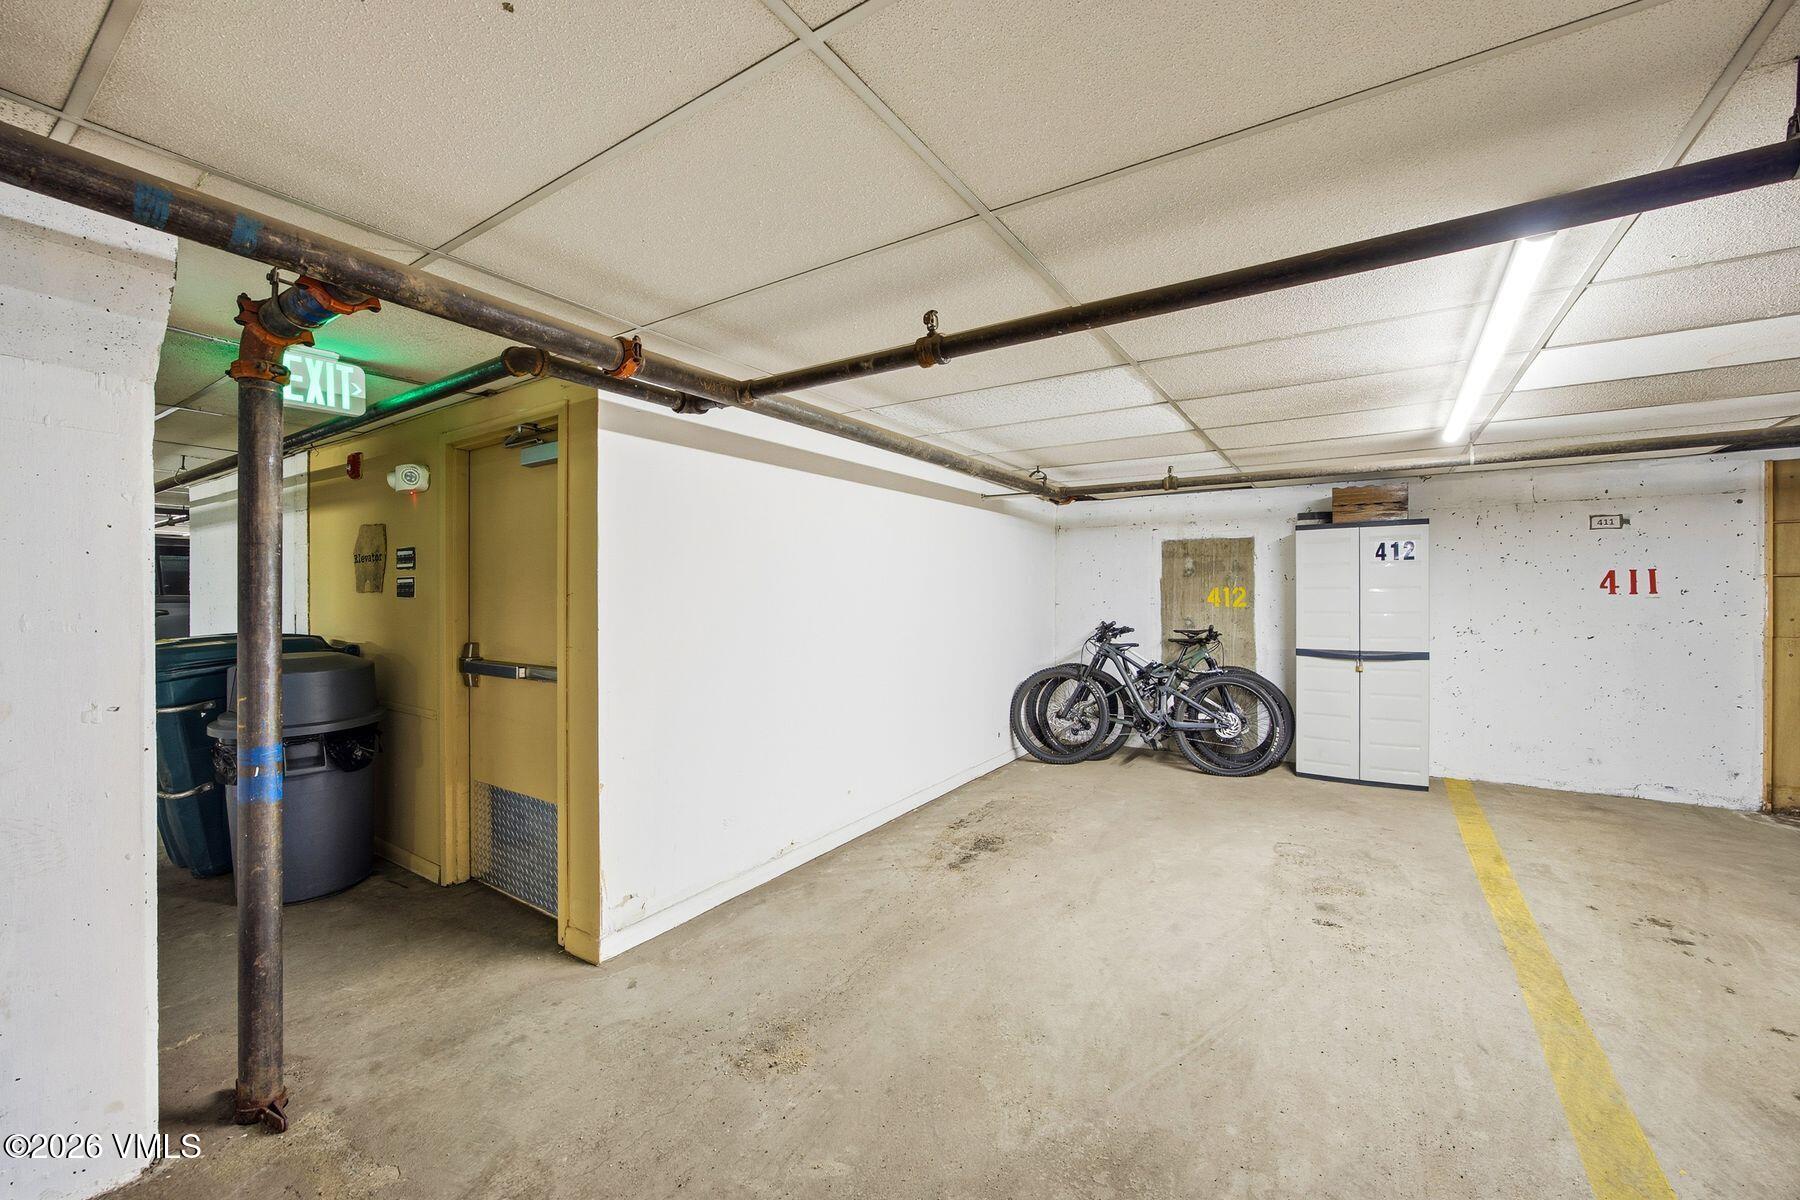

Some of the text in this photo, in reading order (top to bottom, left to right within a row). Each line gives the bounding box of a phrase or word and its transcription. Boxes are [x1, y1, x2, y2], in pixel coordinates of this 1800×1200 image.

[283, 354, 354, 410] EXIT
[1597, 518, 1615, 526] 411
[354, 553, 382, 564] Elevator
[1375, 541, 1415, 561] 412
[1599, 568, 1658, 595] 411
[1207, 586, 1248, 608] 412
